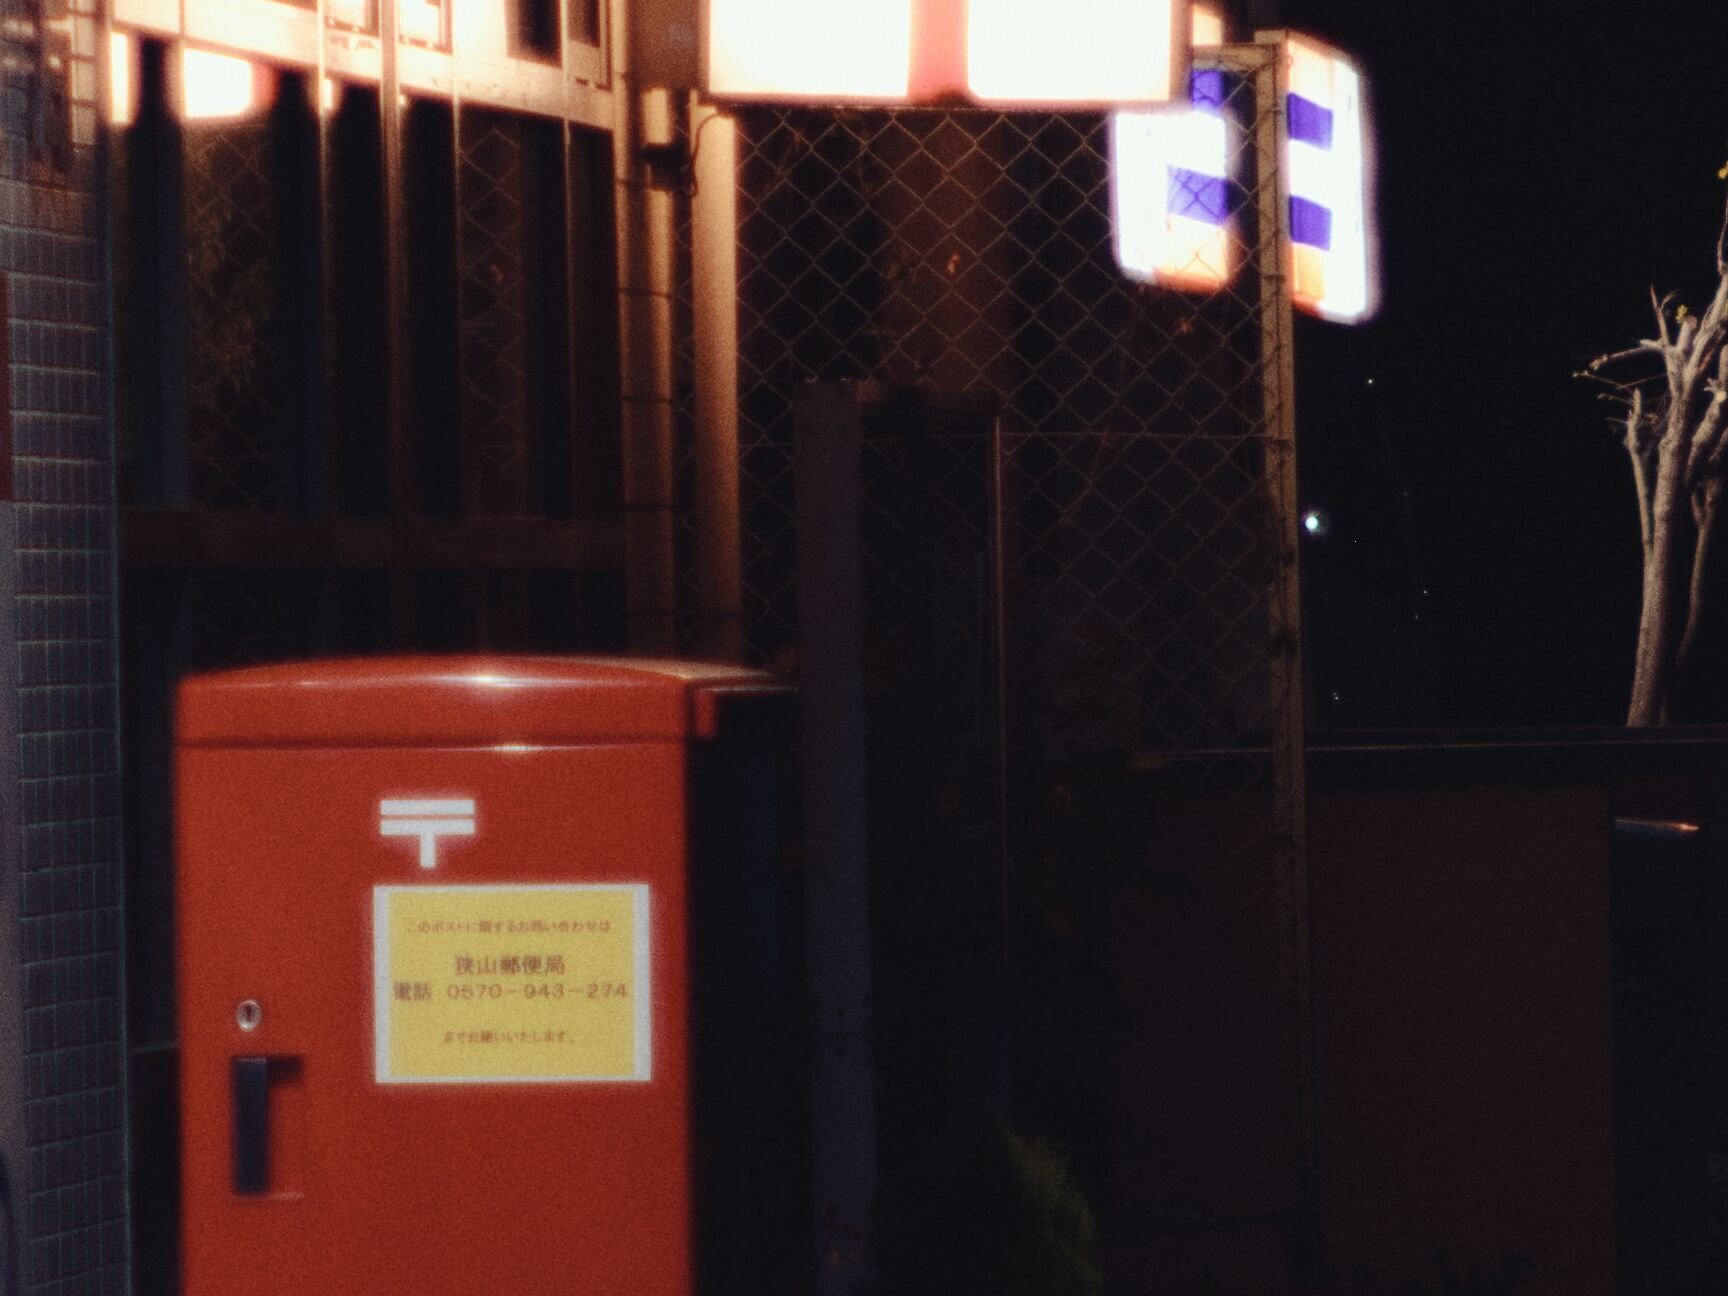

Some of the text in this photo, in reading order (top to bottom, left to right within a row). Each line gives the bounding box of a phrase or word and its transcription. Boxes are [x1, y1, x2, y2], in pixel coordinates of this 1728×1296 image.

[455, 955, 566, 976] 狭山郵便局
[393, 981, 432, 1001] 電話
